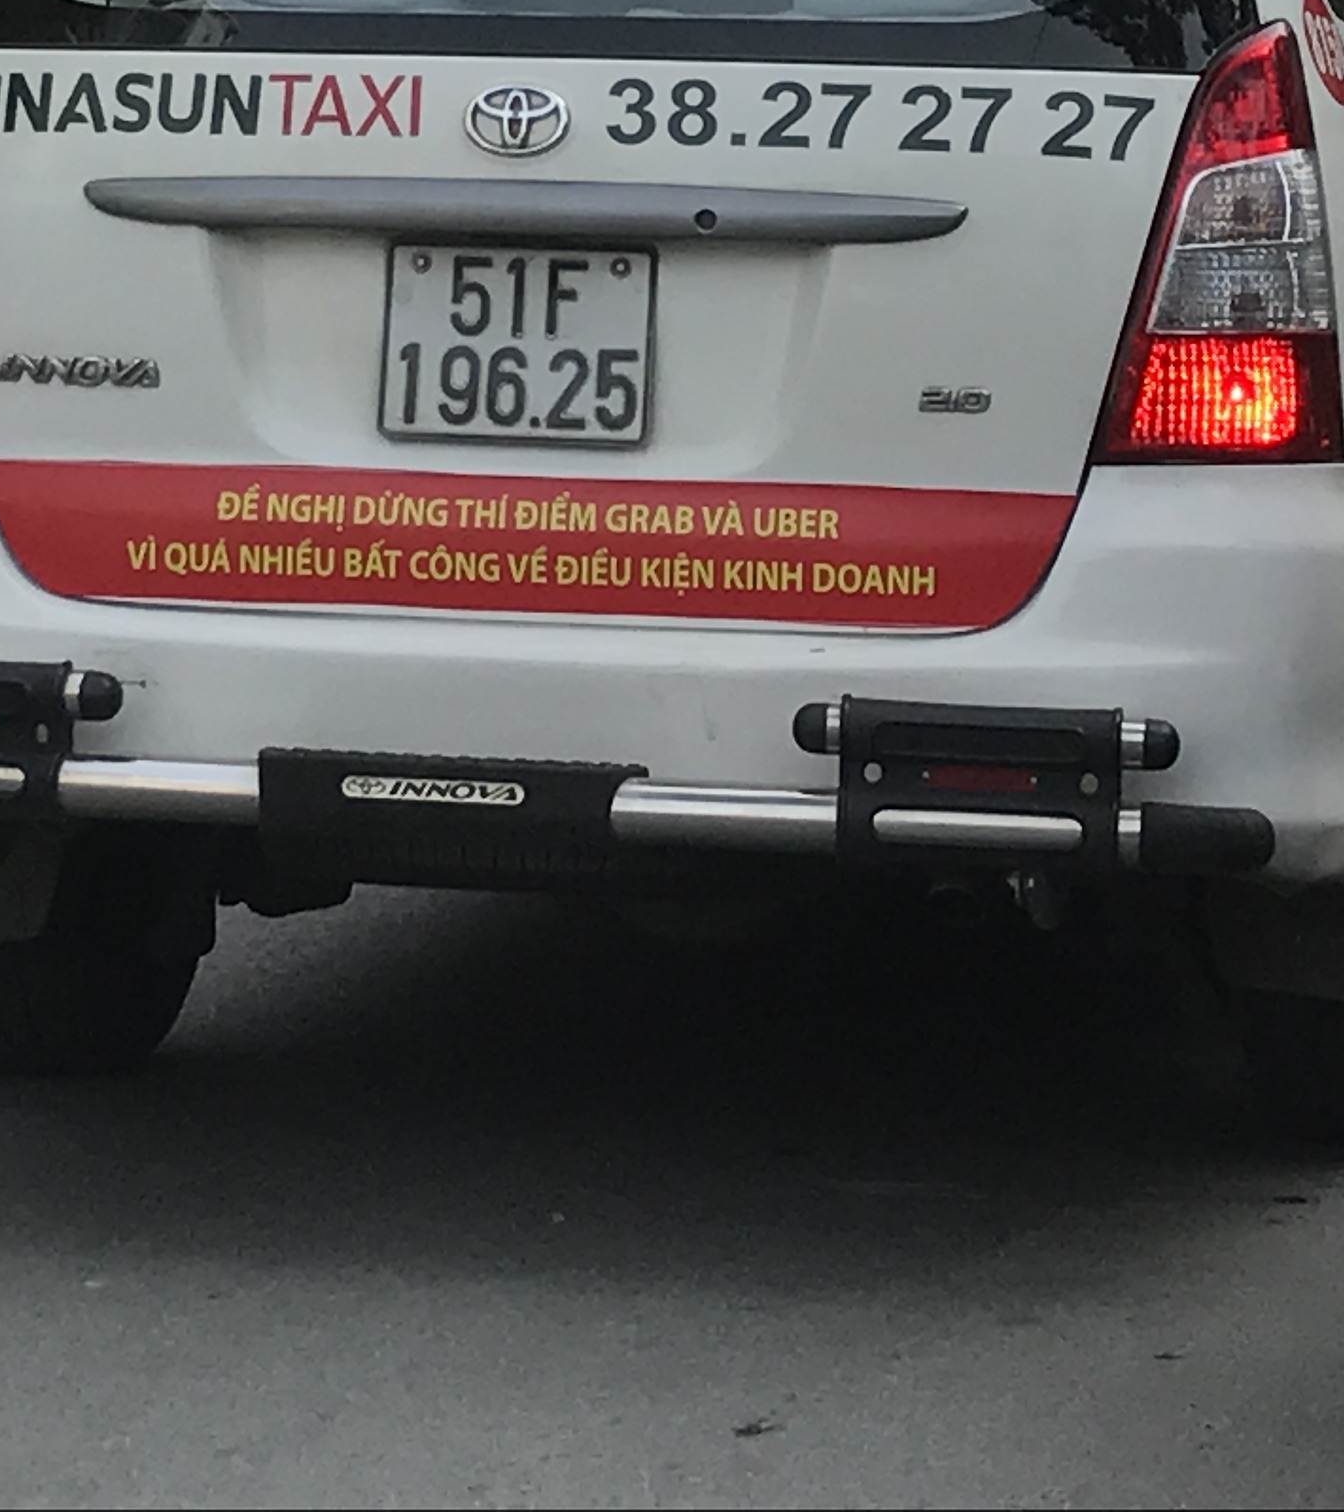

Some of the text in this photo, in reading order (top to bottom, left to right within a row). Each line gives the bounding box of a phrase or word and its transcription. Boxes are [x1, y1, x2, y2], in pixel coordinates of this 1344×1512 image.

[898, 85, 1012, 154] 27
[1041, 90, 1156, 162] 27
[450, 256, 589, 338] 51F
[400, 342, 639, 431] 196.25
[217, 484, 839, 539] ĐỀ NGHỊ DỪNG THÍ ĐIỂM GRAB VÀ UBER
[126, 534, 936, 596] VÌ QUÁ NHIỀU BẤT CÔNG VỀ ĐIỀU KIỆN KINH DOANH
[389, 780, 517, 801] INNOVA
